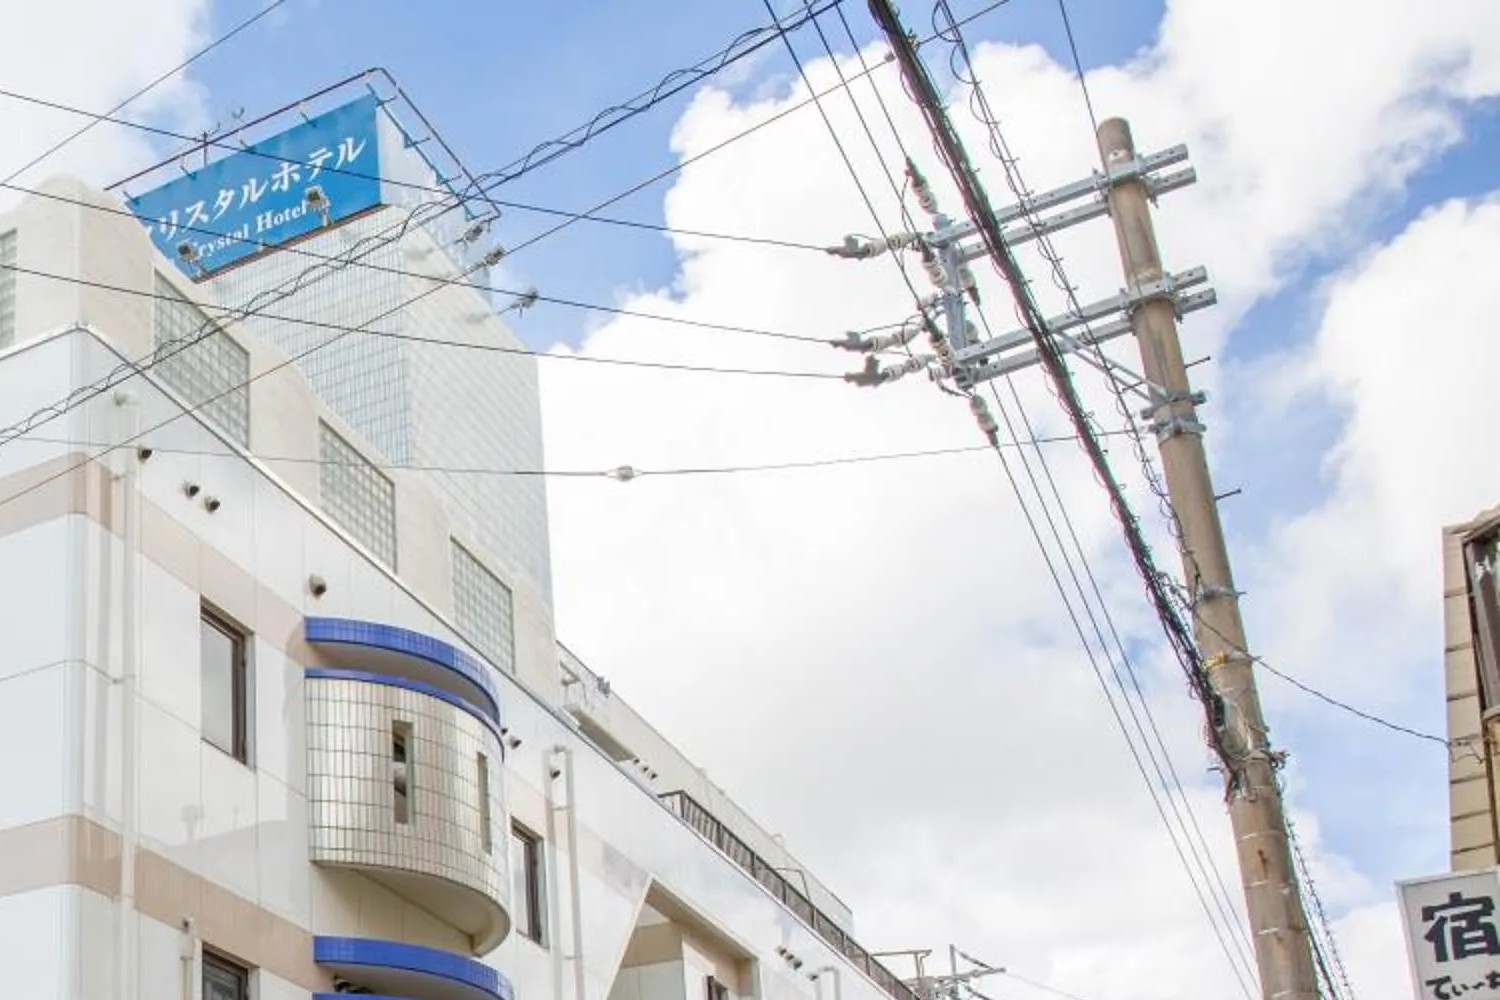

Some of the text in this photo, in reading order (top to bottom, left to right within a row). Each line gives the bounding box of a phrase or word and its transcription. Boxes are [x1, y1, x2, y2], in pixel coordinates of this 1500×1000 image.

[147, 136, 368, 241] リスタルホテル
[188, 199, 308, 258] rystal Hotel
[1421, 891, 1500, 963] 宿
